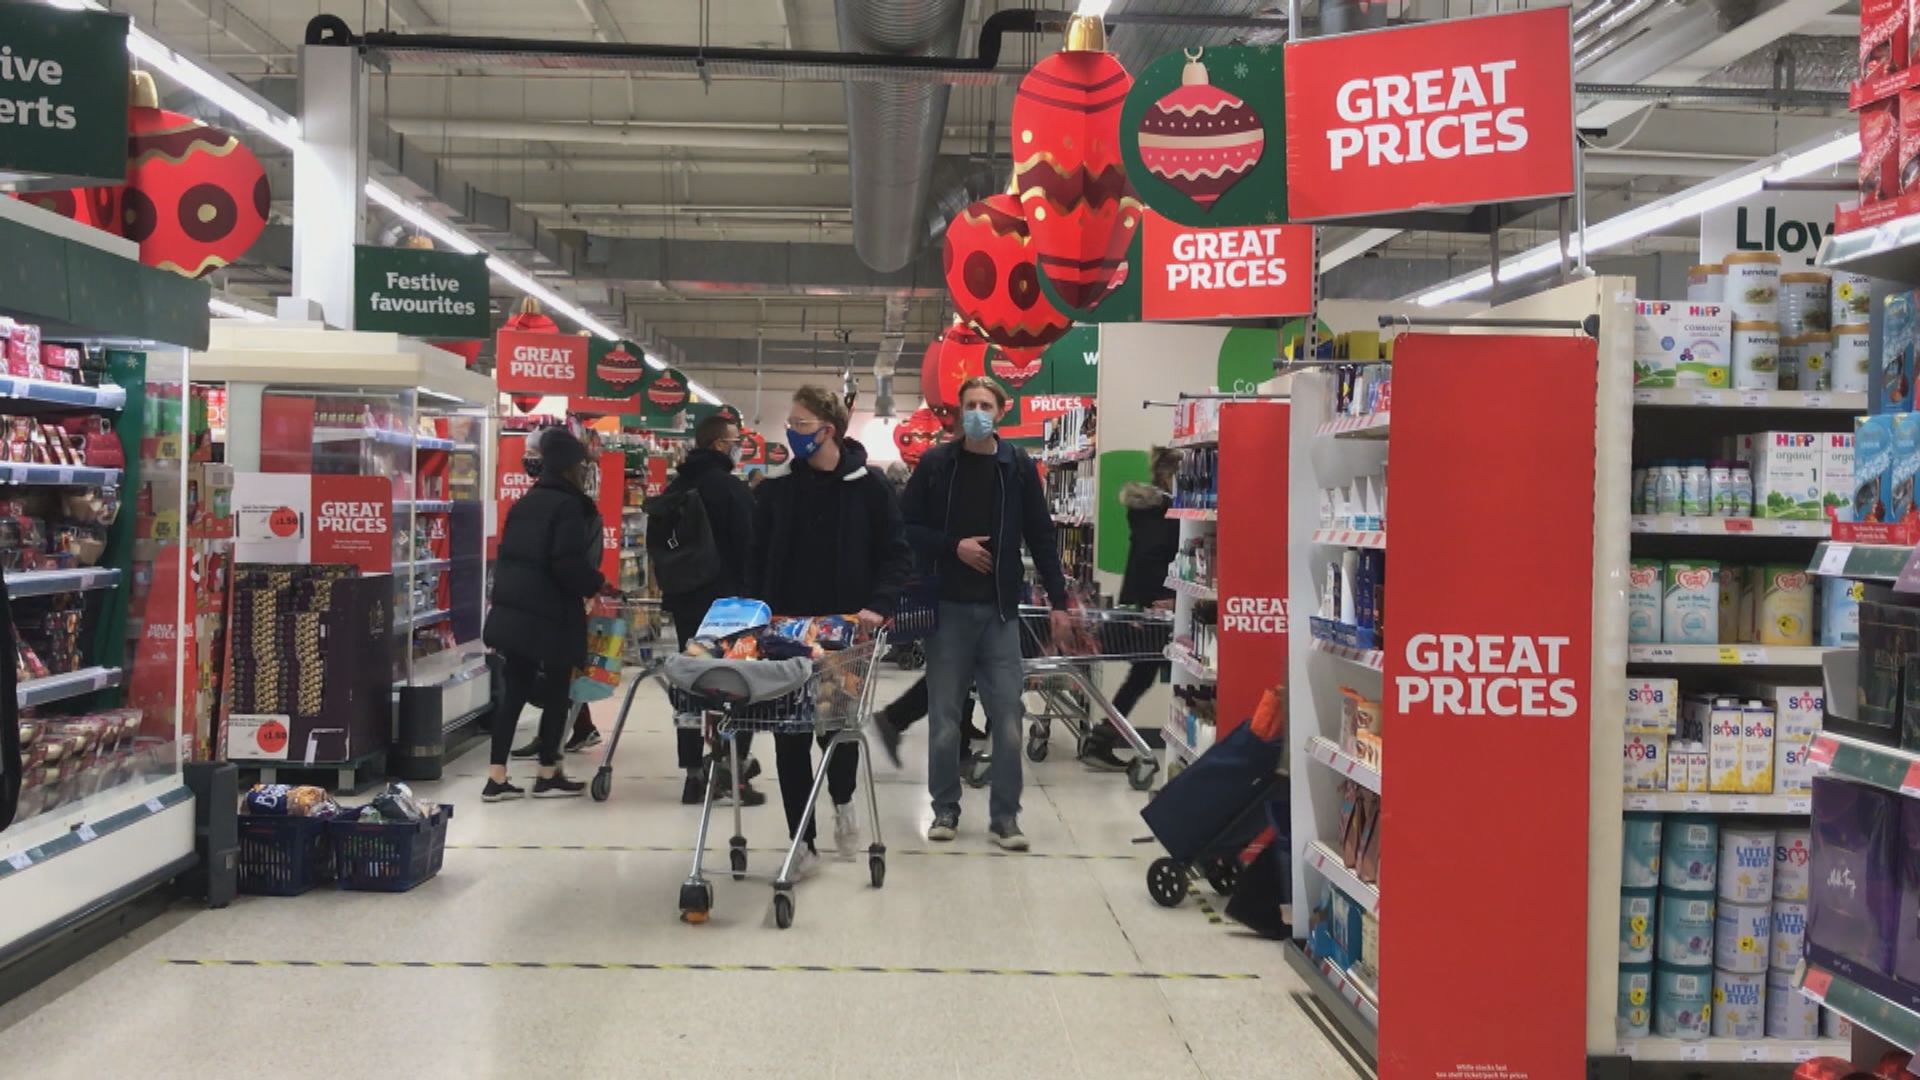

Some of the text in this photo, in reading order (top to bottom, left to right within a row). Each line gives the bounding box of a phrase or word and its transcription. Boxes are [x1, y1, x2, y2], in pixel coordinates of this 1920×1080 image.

[1336, 60, 1517, 122] GREAT
[1326, 107, 1529, 171] PRICES
[1172, 228, 1282, 261] GREAT
[386, 272, 460, 293] Festive
[1166, 258, 1287, 291] PRICES
[370, 292, 476, 315] favourites
[1636, 302, 1671, 315] HiPP
[1690, 305, 1721, 317] HiPP
[513, 346, 573, 363] GREAT
[510, 362, 575, 379] PRICES
[1030, 398, 1082, 412] PRICES
[1776, 434, 1815, 447] HiPP
[1776, 450, 1813, 464] organic
[503, 473, 539, 486] GRE
[1811, 468, 1817, 482] 1
[321, 501, 384, 517] GREAT
[317, 516, 387, 533] PRICES
[1222, 614, 1289, 633] PRICE
[1405, 633, 1570, 674] GREAT
[1395, 676, 1578, 717] PRICES
[1628, 682, 1664, 704] sma
[1789, 691, 1824, 713] sma
[1713, 720, 1740, 737] sma
[1745, 722, 1772, 738] sma
[1736, 846, 1771, 857] LITTLE
[1738, 857, 1769, 868] STEPS
[1724, 983, 1761, 994] LITTLE
[1726, 993, 1759, 1005] STEPS
